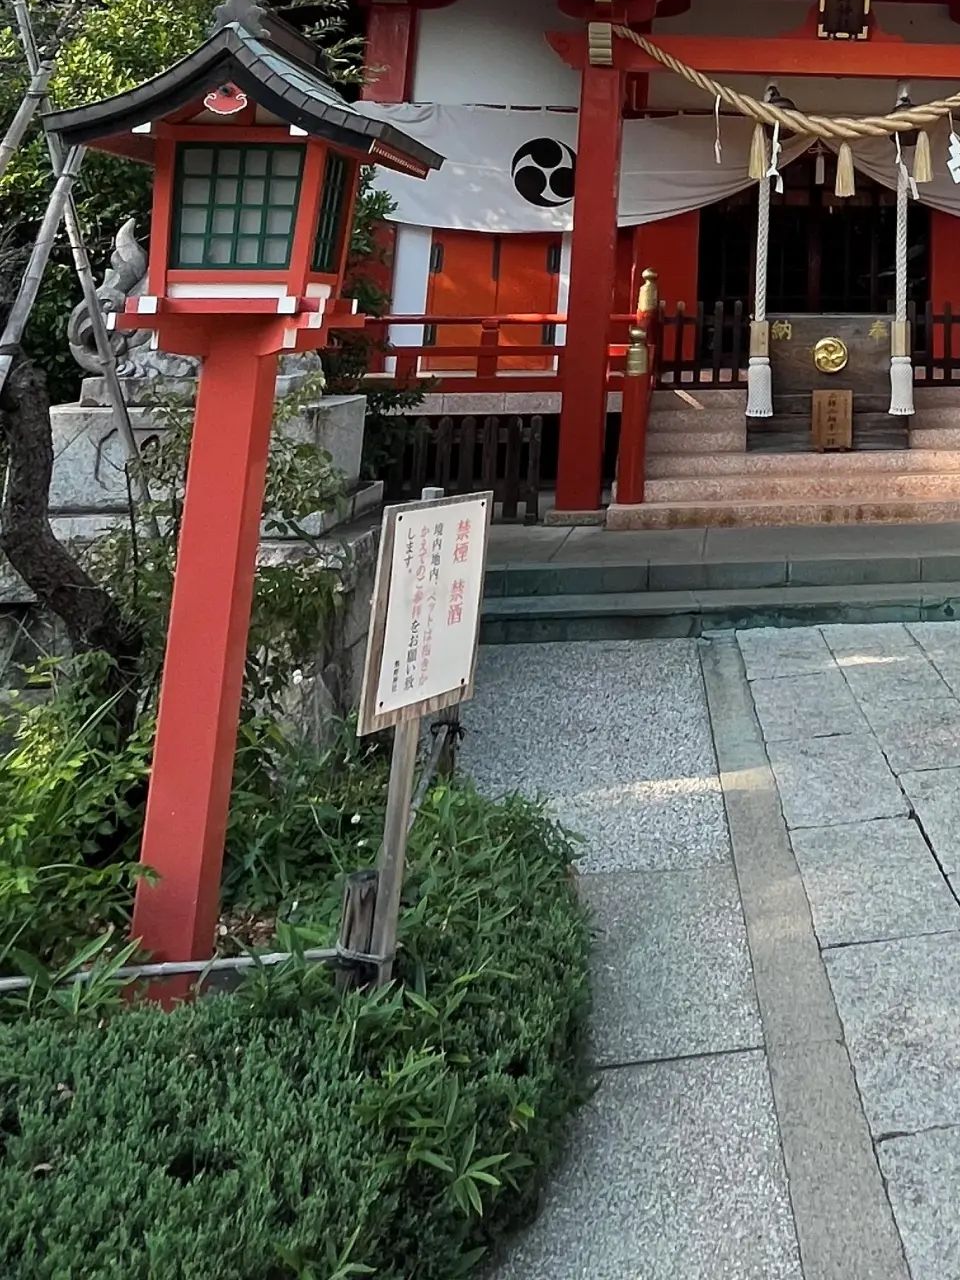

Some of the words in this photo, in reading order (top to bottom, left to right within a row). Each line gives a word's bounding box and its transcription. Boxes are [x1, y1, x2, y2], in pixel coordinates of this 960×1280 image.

[771, 320, 792, 340] 納
[868, 320, 889, 345] 奉
[403, 527, 416, 573] します。
[452, 518, 472, 563] 禁煙
[447, 579, 466, 626] 禁酒
